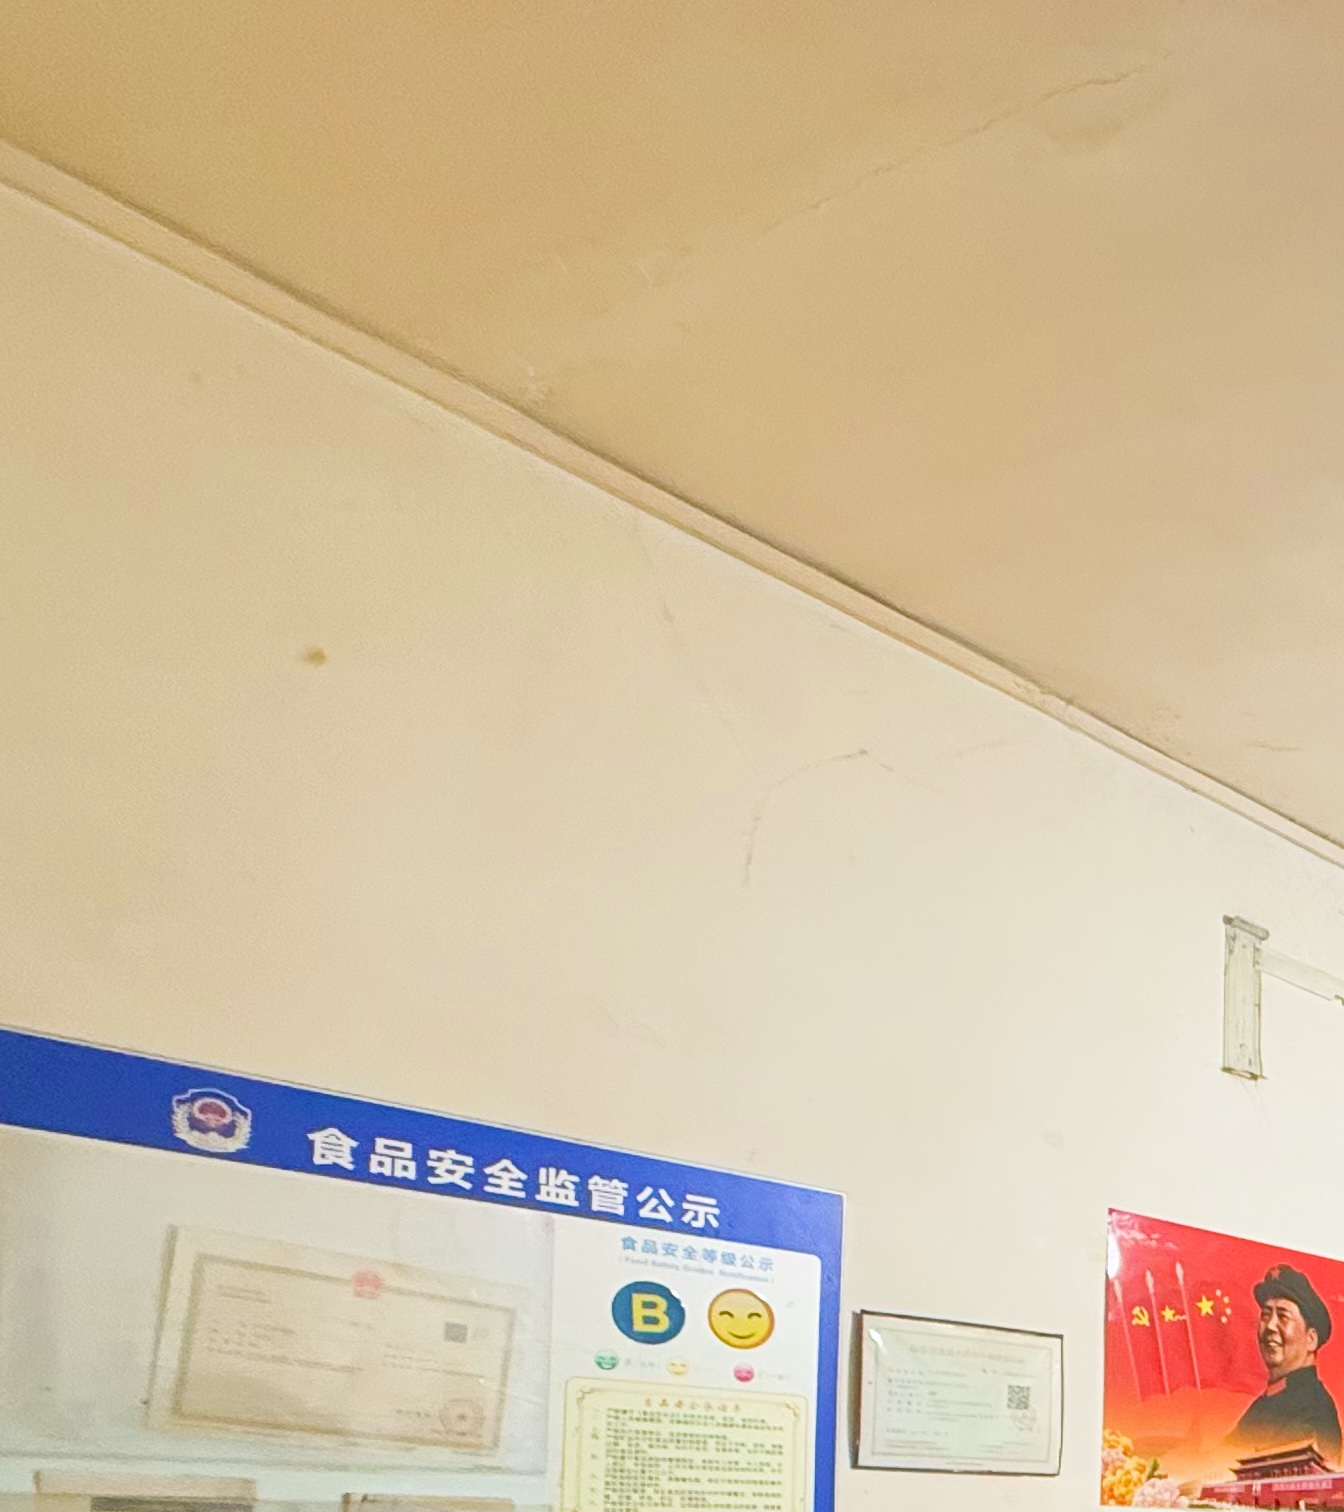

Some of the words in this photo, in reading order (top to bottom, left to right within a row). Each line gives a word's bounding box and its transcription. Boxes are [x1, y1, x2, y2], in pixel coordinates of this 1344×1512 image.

[306, 1127, 721, 1230] 食品安全监管公示
[620, 1235, 775, 1272] 食品安全等级公示
[631, 1292, 670, 1333] B
